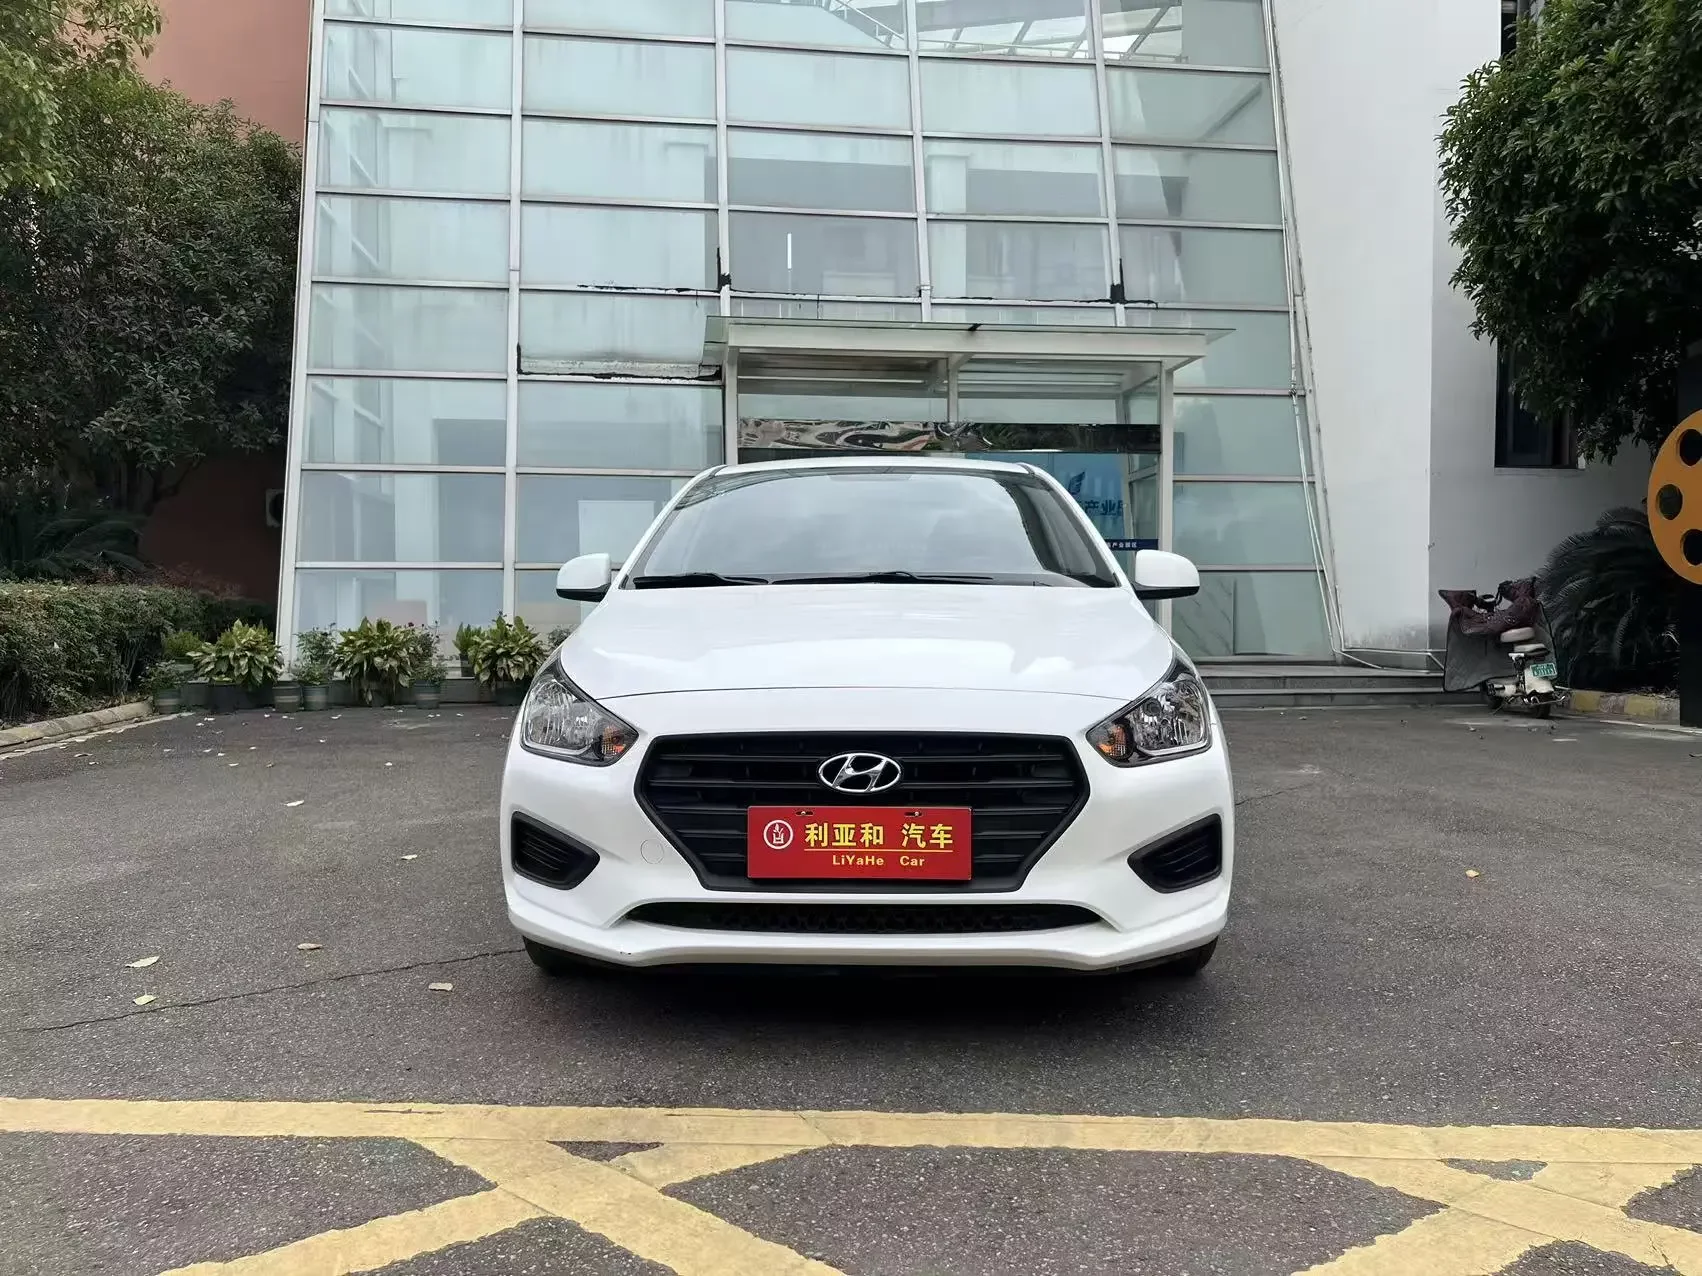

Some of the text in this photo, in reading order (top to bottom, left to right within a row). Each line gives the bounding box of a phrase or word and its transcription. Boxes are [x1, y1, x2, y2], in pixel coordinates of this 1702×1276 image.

[1077, 499, 1123, 516] 产业
[804, 822, 954, 849] 利亚和 汽车
[832, 854, 926, 867] LiYaHe Car
